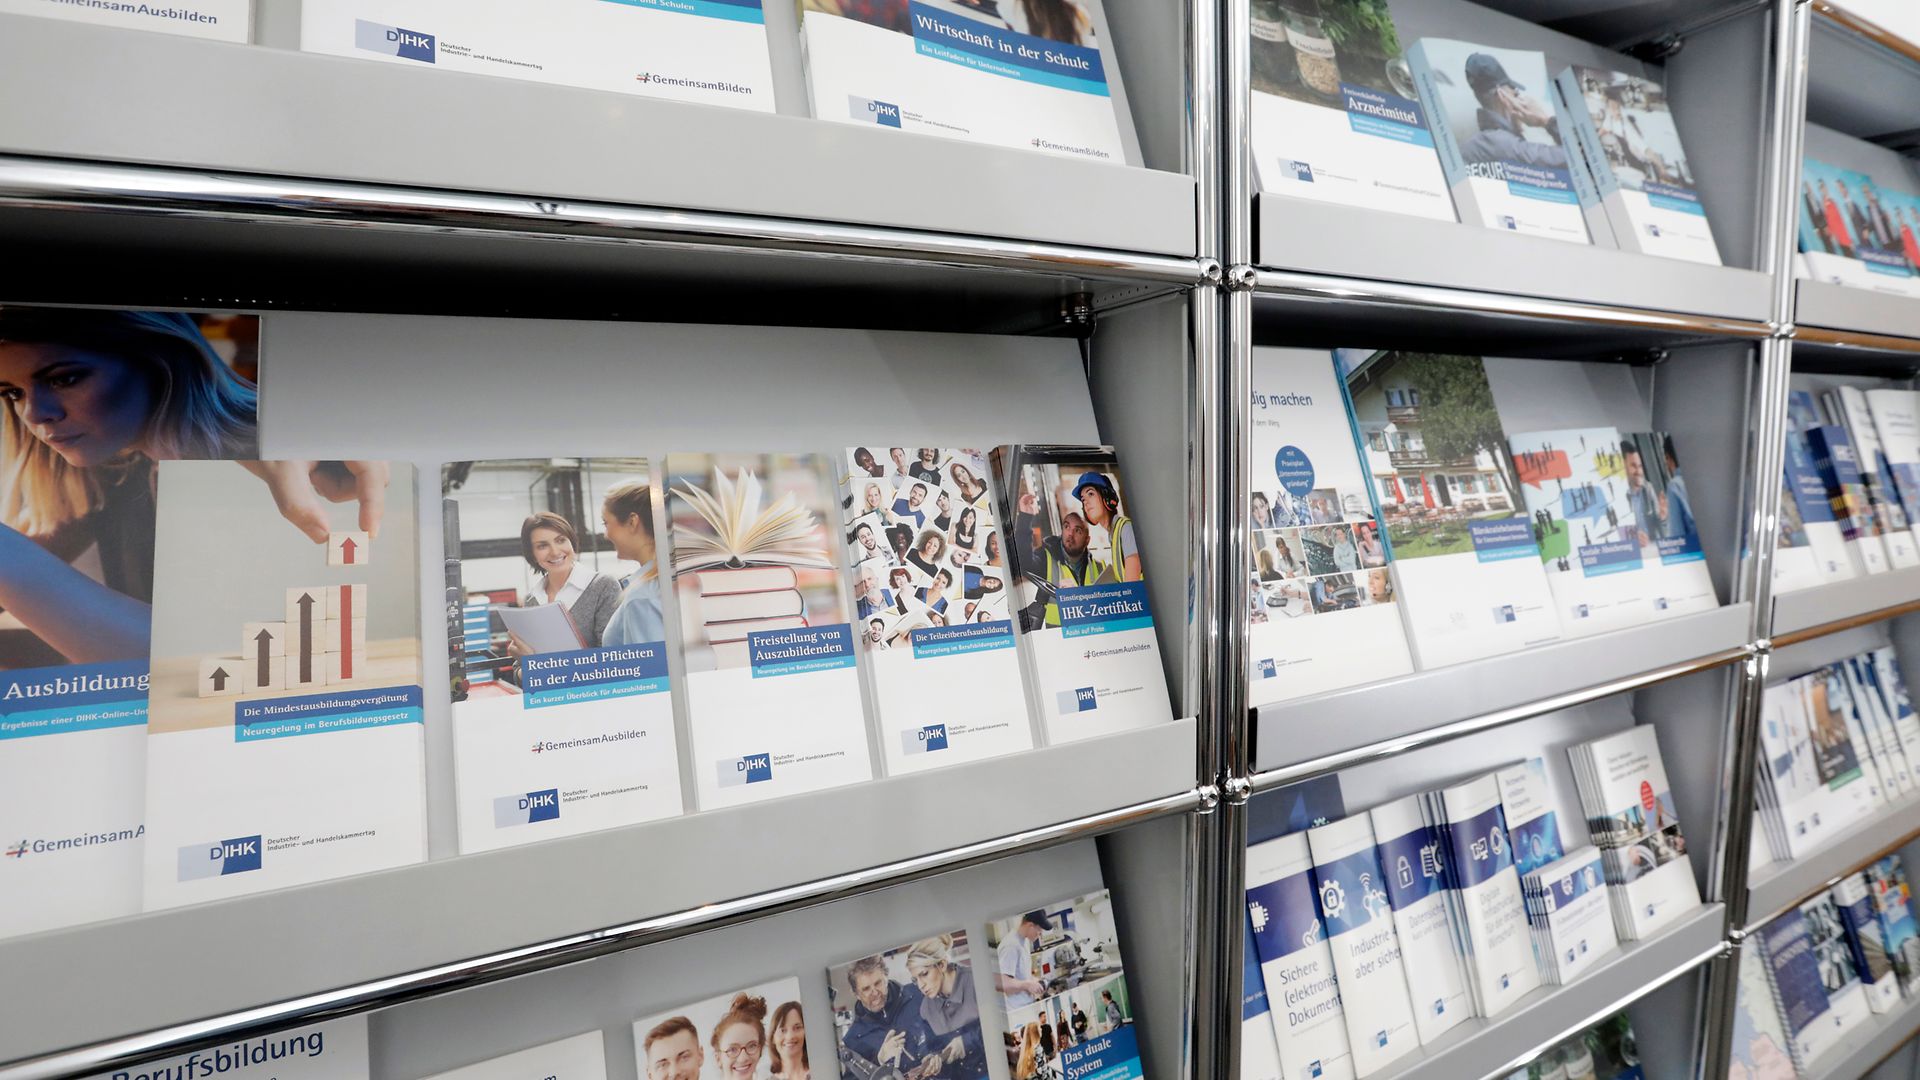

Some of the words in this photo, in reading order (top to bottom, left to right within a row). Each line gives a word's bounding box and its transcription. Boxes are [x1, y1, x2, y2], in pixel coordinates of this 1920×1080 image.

[42, 0, 218, 24] einsamAusbilden
[386, 30, 430, 49] DIHK
[440, 41, 472, 52] Deutscher
[916, 14, 994, 49] Wirtschaft
[999, 38, 1013, 54] in
[1018, 44, 1040, 60] der
[1045, 50, 1090, 70] Schule
[921, 44, 933, 54] Ein
[440, 47, 471, 57] Industrie-
[486, 55, 543, 70] Handelskammertag
[868, 102, 897, 117] DIHK
[1349, 96, 1418, 125] Arzneimittel
[1270, 392, 1313, 406] machen
[1061, 600, 1144, 620] IHK-Zertifikat
[753, 632, 818, 647] Freistellung
[820, 631, 841, 640] von
[916, 634, 928, 642] Die
[929, 625, 1008, 640] Teilzeitberufsausbildung
[528, 657, 569, 671] Rechte
[574, 653, 598, 665] und
[601, 649, 654, 662] Pflichten
[755, 643, 843, 661] Auszubildenden
[3, 673, 150, 700] Ausbildung
[529, 676, 542, 687] in
[546, 674, 567, 685] der
[571, 666, 641, 682] Ausbildung
[529, 697, 541, 705] Ein
[543, 694, 564, 703] kurzer
[566, 691, 598, 700] Überblick
[600, 688, 610, 696] für
[612, 683, 657, 694] Auszubildende
[1078, 690, 1094, 701] IHK
[244, 707, 261, 717] Die
[264, 693, 408, 714] Mindestausbildungsvergütung
[1, 719, 48, 731] Ergebnisse
[51, 717, 73, 725] einer
[243, 725, 302, 737] Neuregelung
[304, 721, 316, 730] im
[319, 712, 408, 728] Berufsbildungsgesetz
[531, 729, 647, 754] #GemeinsamAusbilden
[918, 728, 944, 741] DIHK
[737, 757, 767, 772] DIHK
[562, 789, 588, 797] Deutscher
[601, 784, 648, 796] Handelskammertag
[518, 793, 554, 810] DIHK
[267, 835, 300, 845] Deutscher
[267, 841, 300, 851] Industrie-
[316, 830, 376, 844] Handelskammertag
[210, 841, 256, 861] DIHK
[1350, 928, 1390, 957] Industrie
[1280, 960, 1318, 985] Sichere
[1355, 960, 1376, 979] aber
[1377, 946, 1402, 968] siche
[1064, 1051, 1083, 1065] Das
[1085, 1038, 1112, 1056] duale
[1067, 1058, 1103, 1080] System
